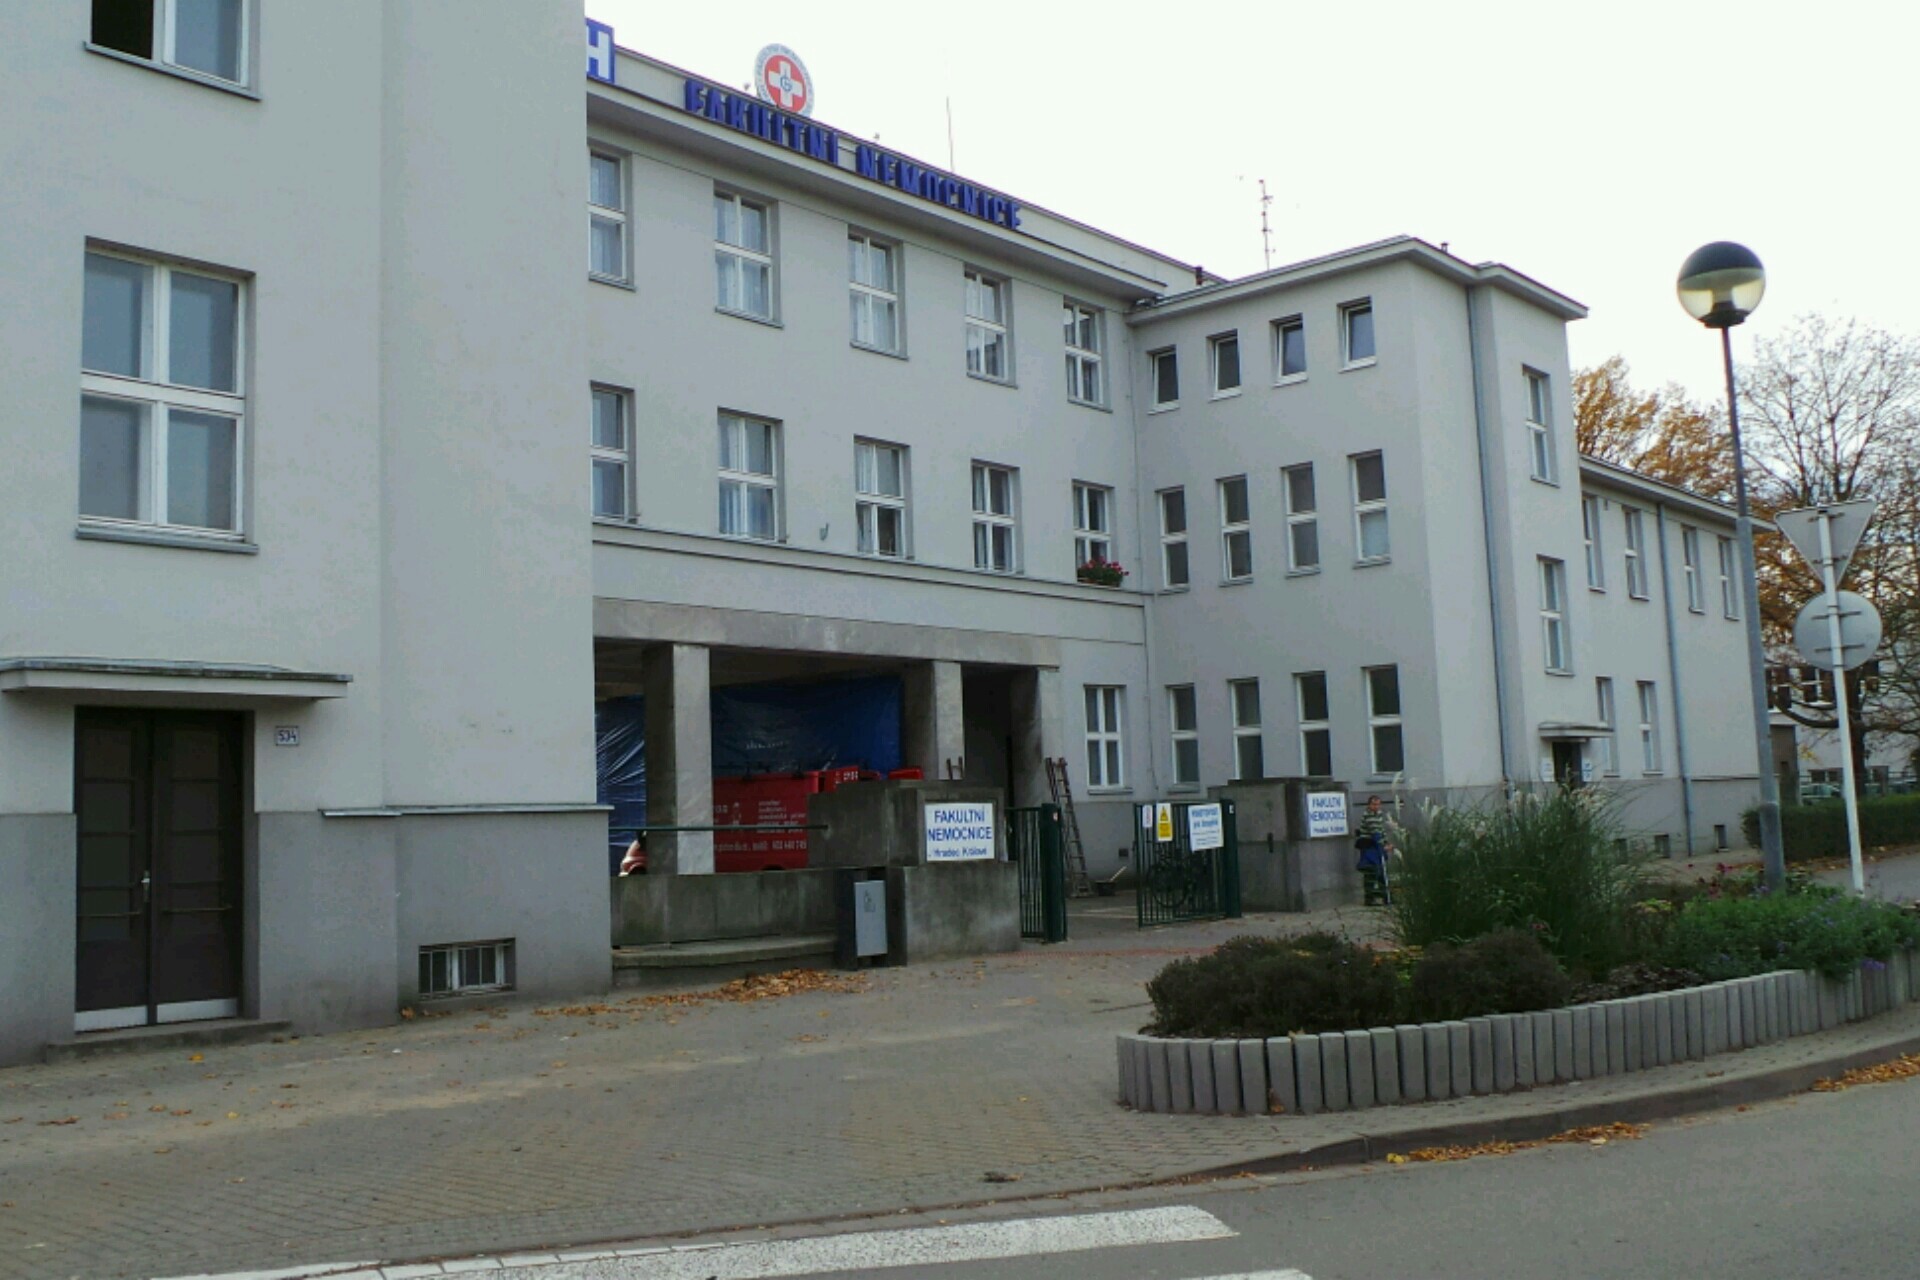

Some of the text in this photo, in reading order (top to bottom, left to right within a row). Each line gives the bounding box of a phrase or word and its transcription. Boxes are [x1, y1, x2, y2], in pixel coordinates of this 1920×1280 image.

[856, 144, 1021, 229] NEMOCNICE
[934, 805, 985, 824] FAKULTNÍ
[928, 826, 993, 842] NEMOCNICE
